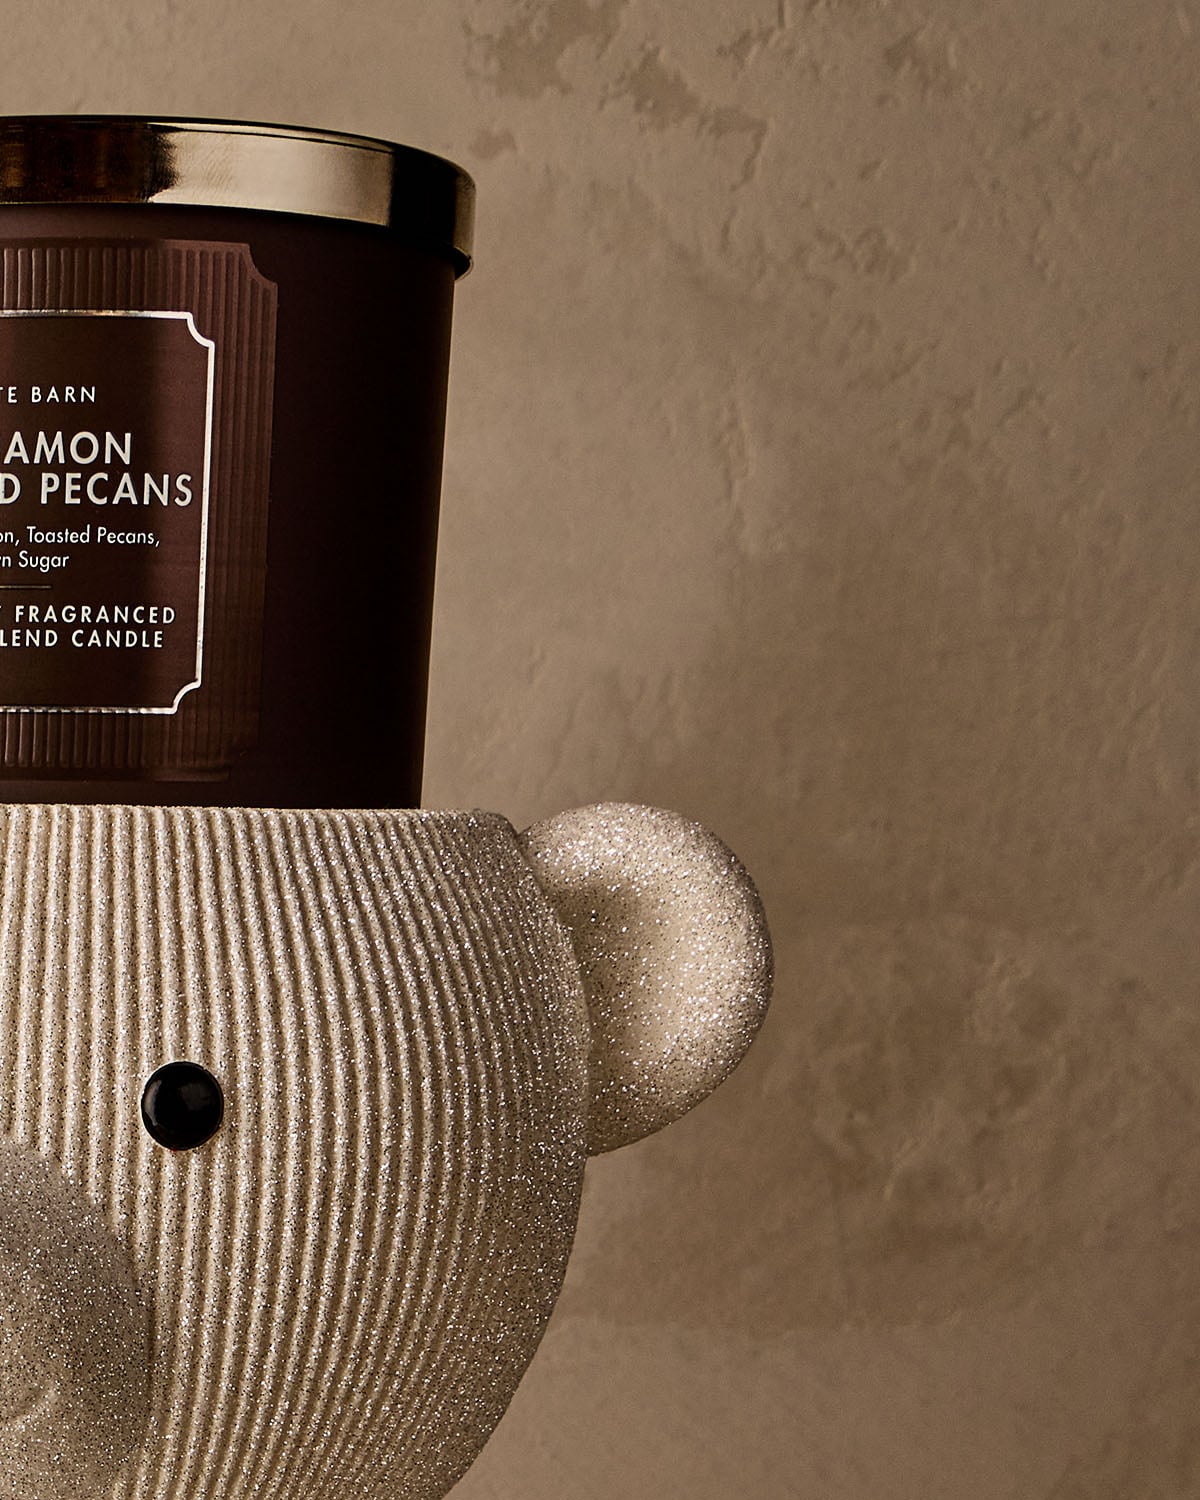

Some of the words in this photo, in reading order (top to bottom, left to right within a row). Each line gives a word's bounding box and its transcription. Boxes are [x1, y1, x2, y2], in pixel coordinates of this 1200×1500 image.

[31, 386, 96, 403] BARN
[40, 472, 192, 506] PECANS
[27, 525, 90, 544] Toasted
[97, 527, 160, 548] Pecans,
[18, 551, 69, 573] Sugar
[15, 606, 176, 624] FRAGRANCED
[72, 630, 163, 648] CANDLE
